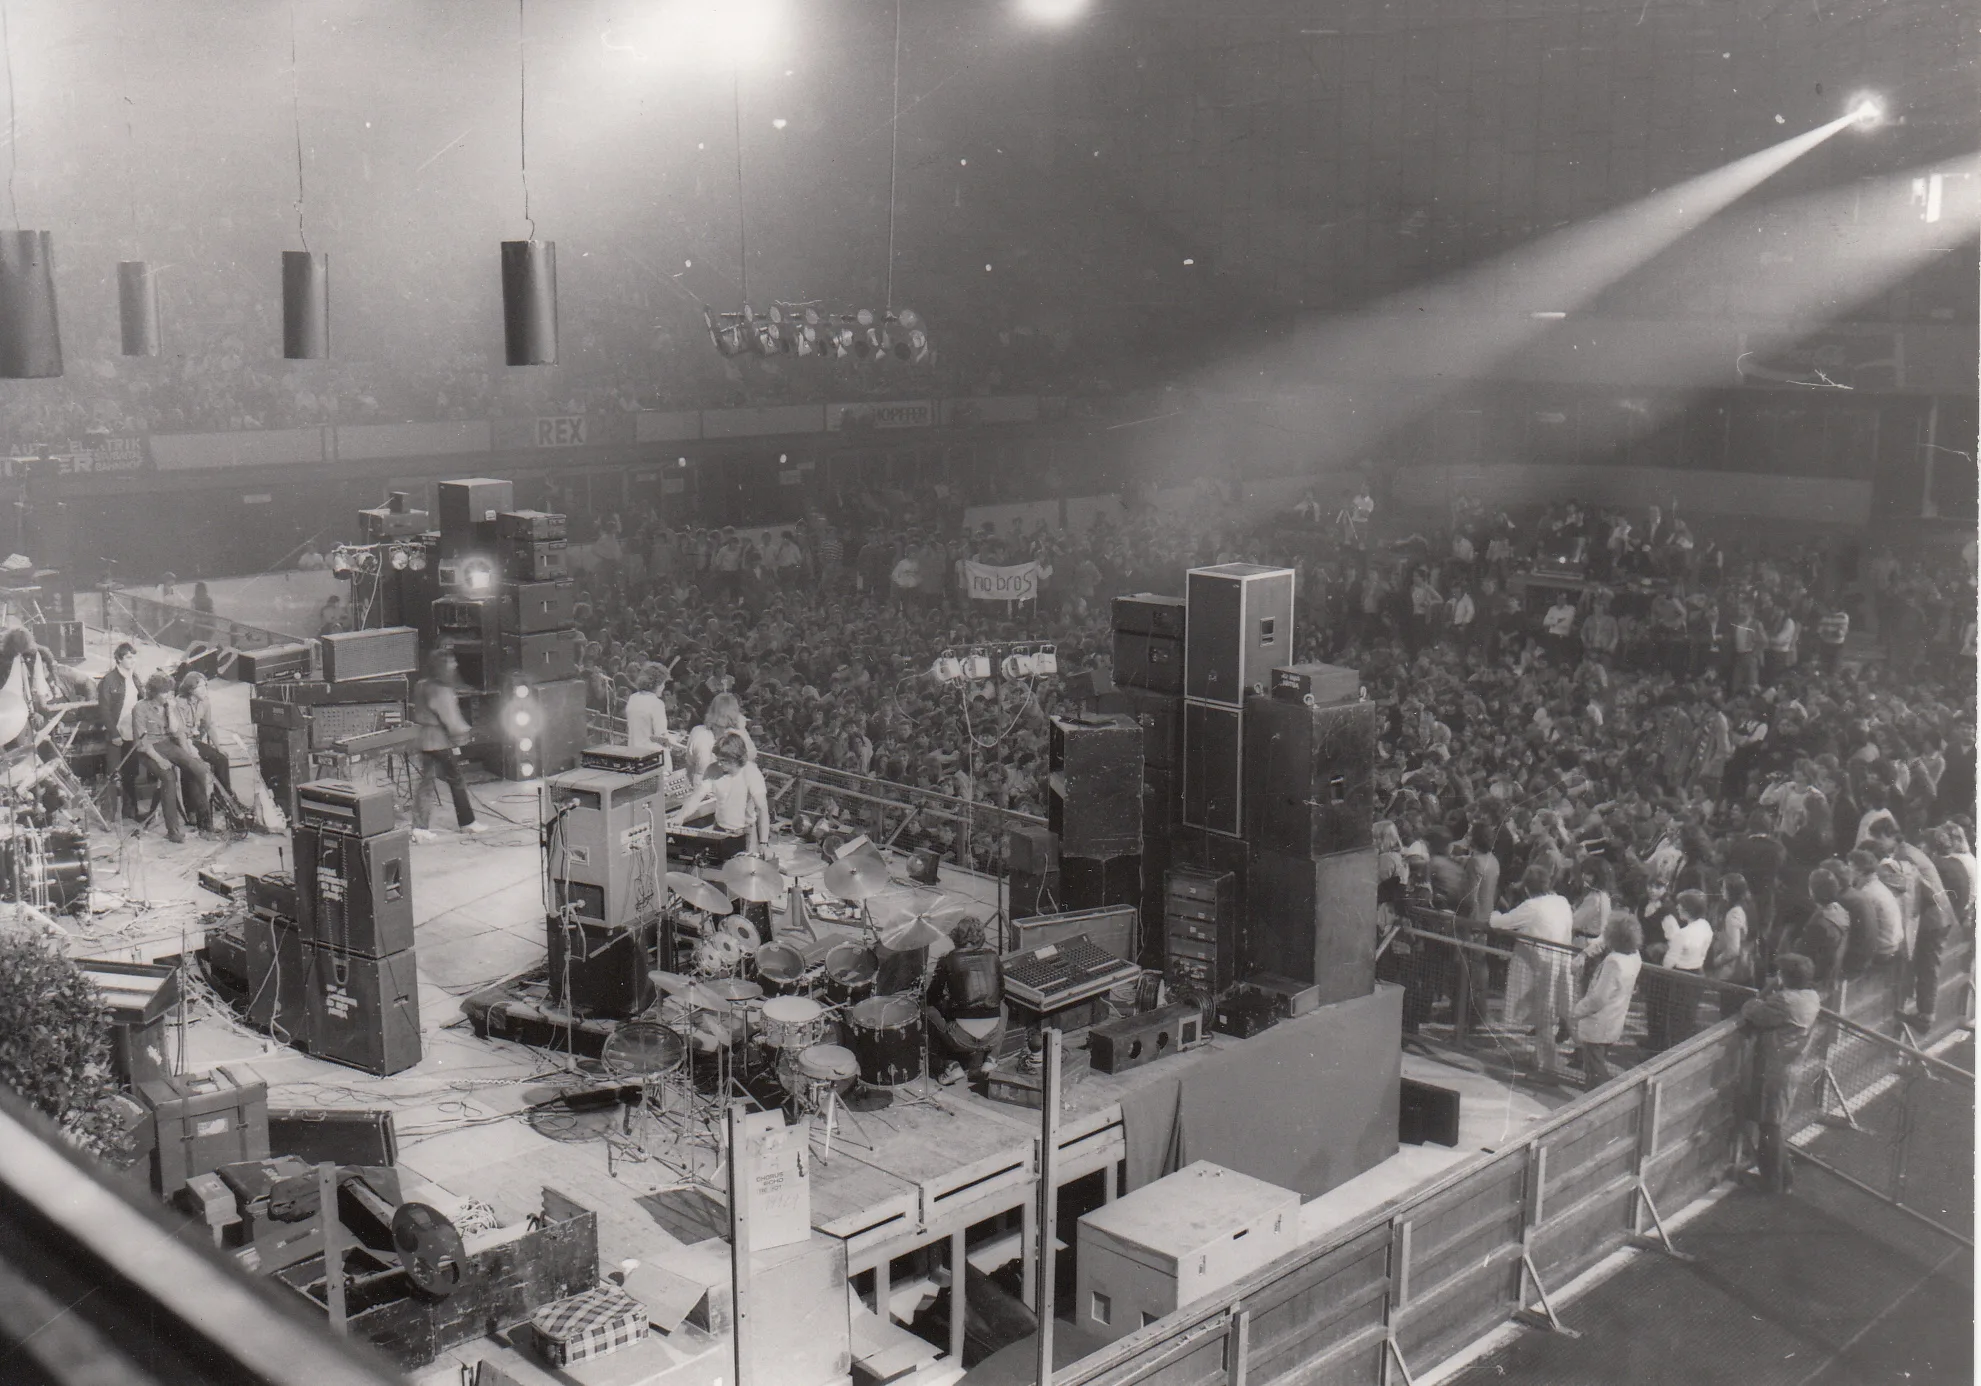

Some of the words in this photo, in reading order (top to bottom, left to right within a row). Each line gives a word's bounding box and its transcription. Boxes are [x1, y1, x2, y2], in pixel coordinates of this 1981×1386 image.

[538, 418, 584, 445] REX
[69, 438, 141, 453] ELTRIK
[974, 576, 992, 592] no
